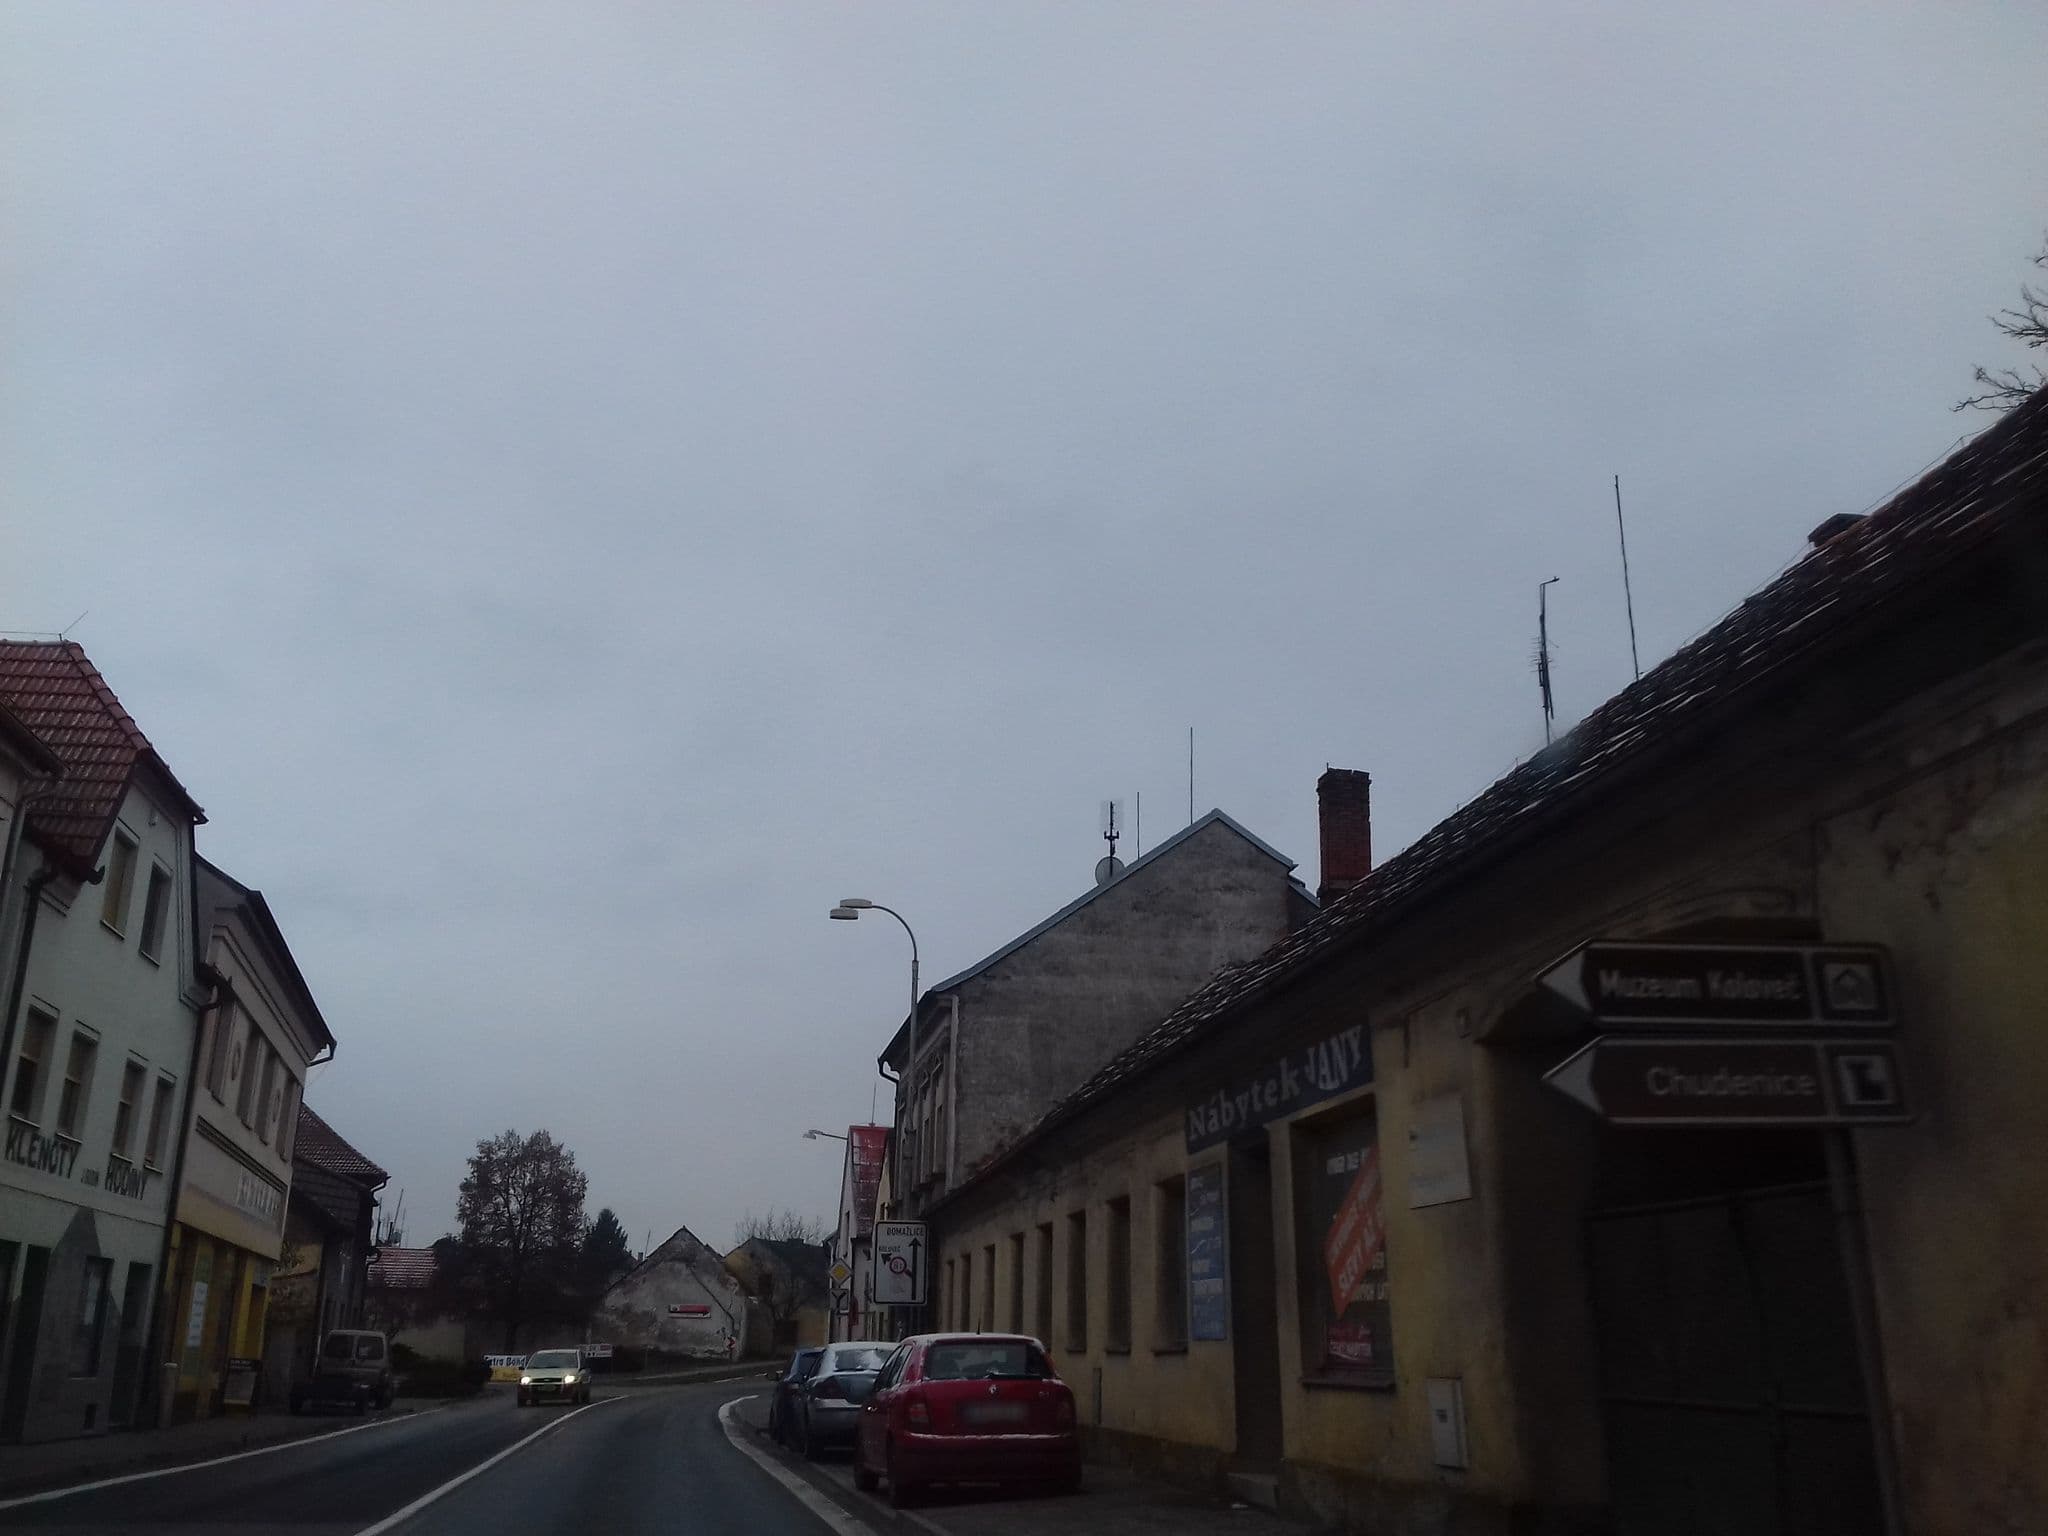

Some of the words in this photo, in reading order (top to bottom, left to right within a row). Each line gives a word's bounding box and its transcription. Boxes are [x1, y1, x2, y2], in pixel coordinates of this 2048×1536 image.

[1599, 969, 1702, 999] Muzeum
[1188, 1056, 1302, 1142] Nábytek
[1304, 1024, 1363, 1091] JANY
[1645, 1066, 1818, 1097] Chudenice
[5, 1122, 81, 1179] KLENOTY
